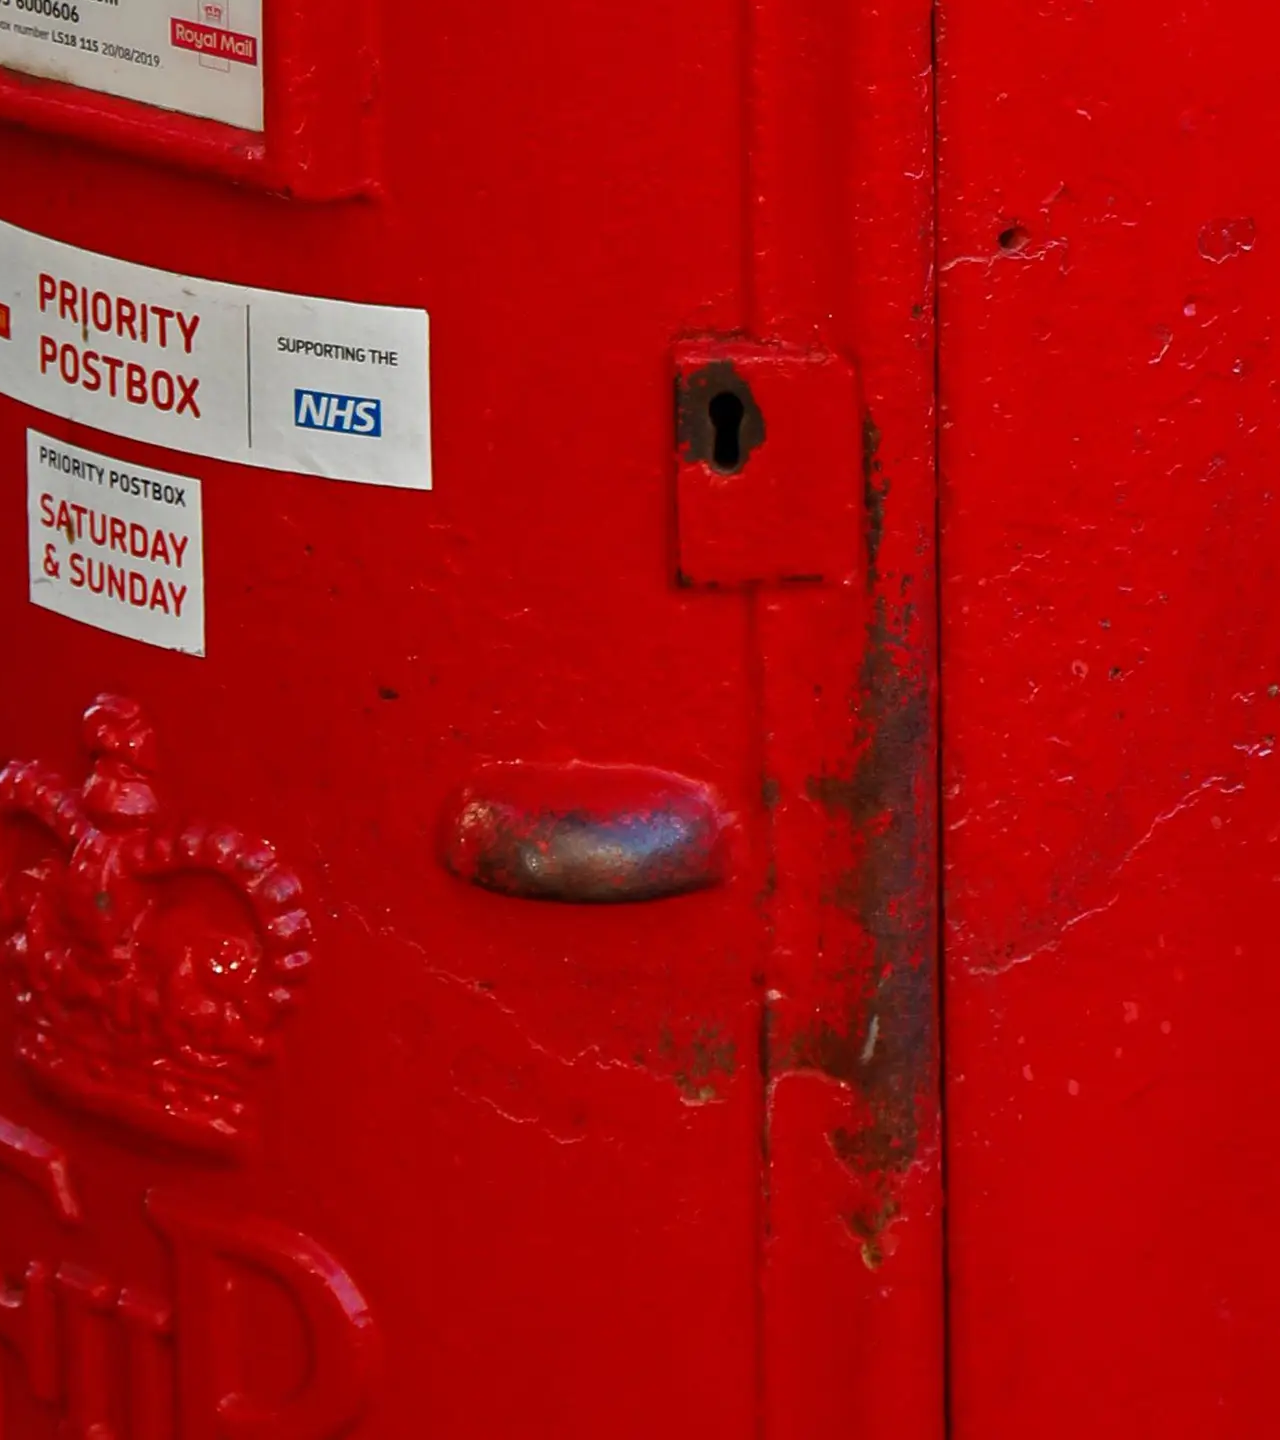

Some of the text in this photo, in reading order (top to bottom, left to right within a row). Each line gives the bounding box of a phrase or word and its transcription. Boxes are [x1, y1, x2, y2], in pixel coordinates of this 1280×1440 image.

[13, 23, 50, 40] number
[51, 29, 77, 48] LS18
[79, 36, 99, 53] 115
[101, 42, 161, 68] 20/08/2019
[174, 23, 253, 58] Royal Mail
[37, 272, 201, 353] PRIORITY
[39, 335, 202, 419] POSTBOX
[277, 336, 399, 367] SUPPORTING THE
[297, 393, 377, 434] NHS
[38, 445, 186, 508] PRIORITY POSTBOX
[39, 493, 189, 570] SATURDAY
[42, 542, 188, 618] & SUNDAY
